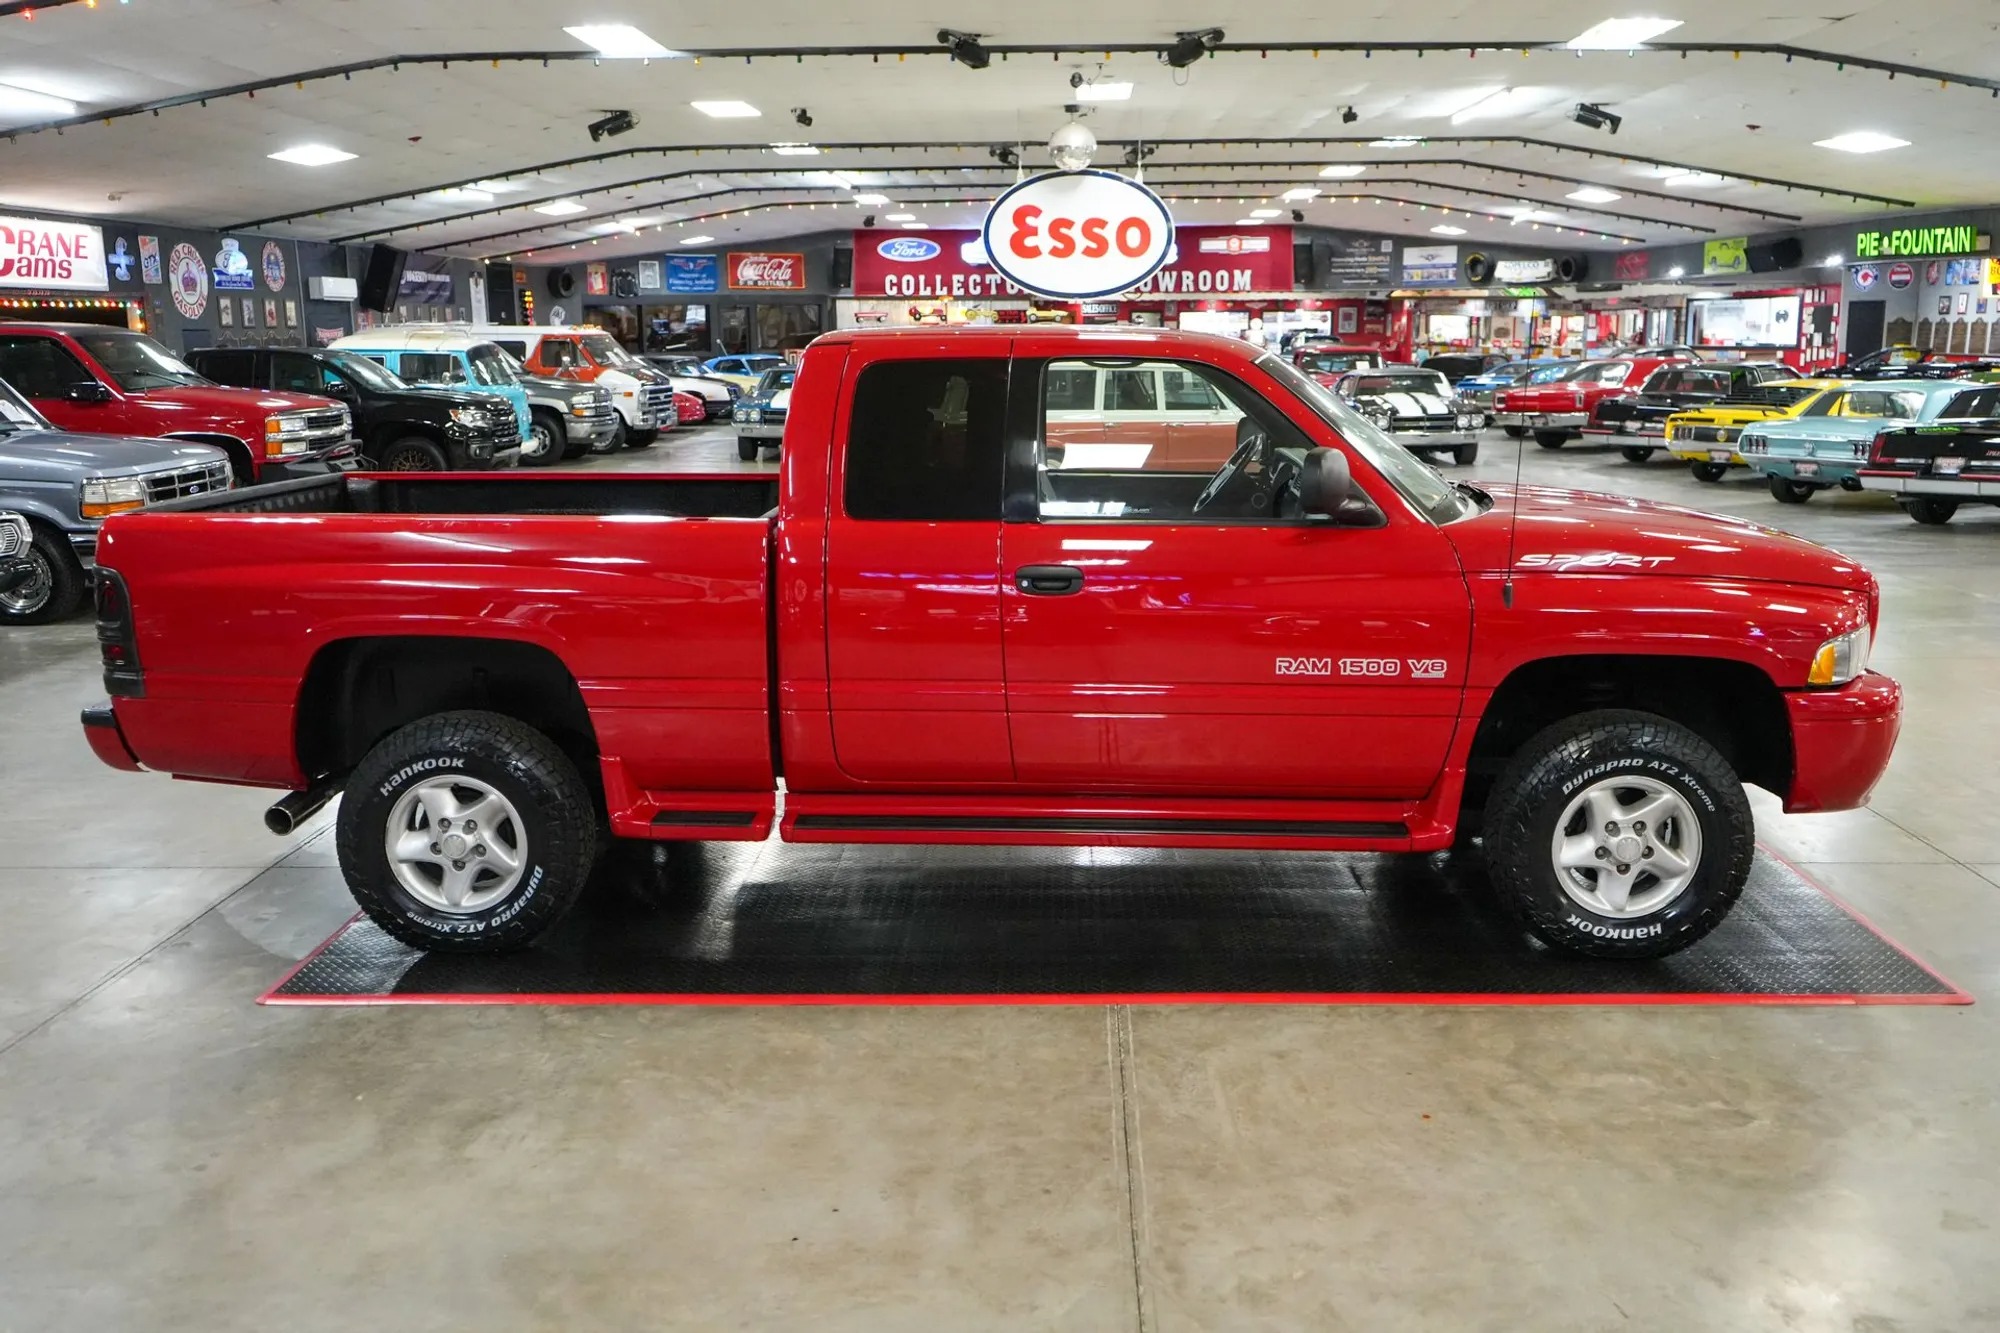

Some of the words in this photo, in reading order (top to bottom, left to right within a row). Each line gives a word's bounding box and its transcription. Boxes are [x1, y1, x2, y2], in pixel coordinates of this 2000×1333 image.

[1009, 204, 1152, 259] Esso
[1857, 233, 1880, 256] PIE
[1891, 226, 1972, 255] FOUNTAIN
[890, 240, 927, 257] Ford
[737, 258, 793, 280] Coca-Cola
[1514, 551, 1676, 572] SPORT
[1275, 657, 1331, 675] RAM
[1338, 658, 1401, 676] 1500
[1406, 659, 1447, 674] V8
[1647, 759, 1679, 776] AT2
[1679, 773, 1716, 812] Xtreme
[407, 911, 452, 933] Xtreme
[457, 920, 487, 934] AT2
